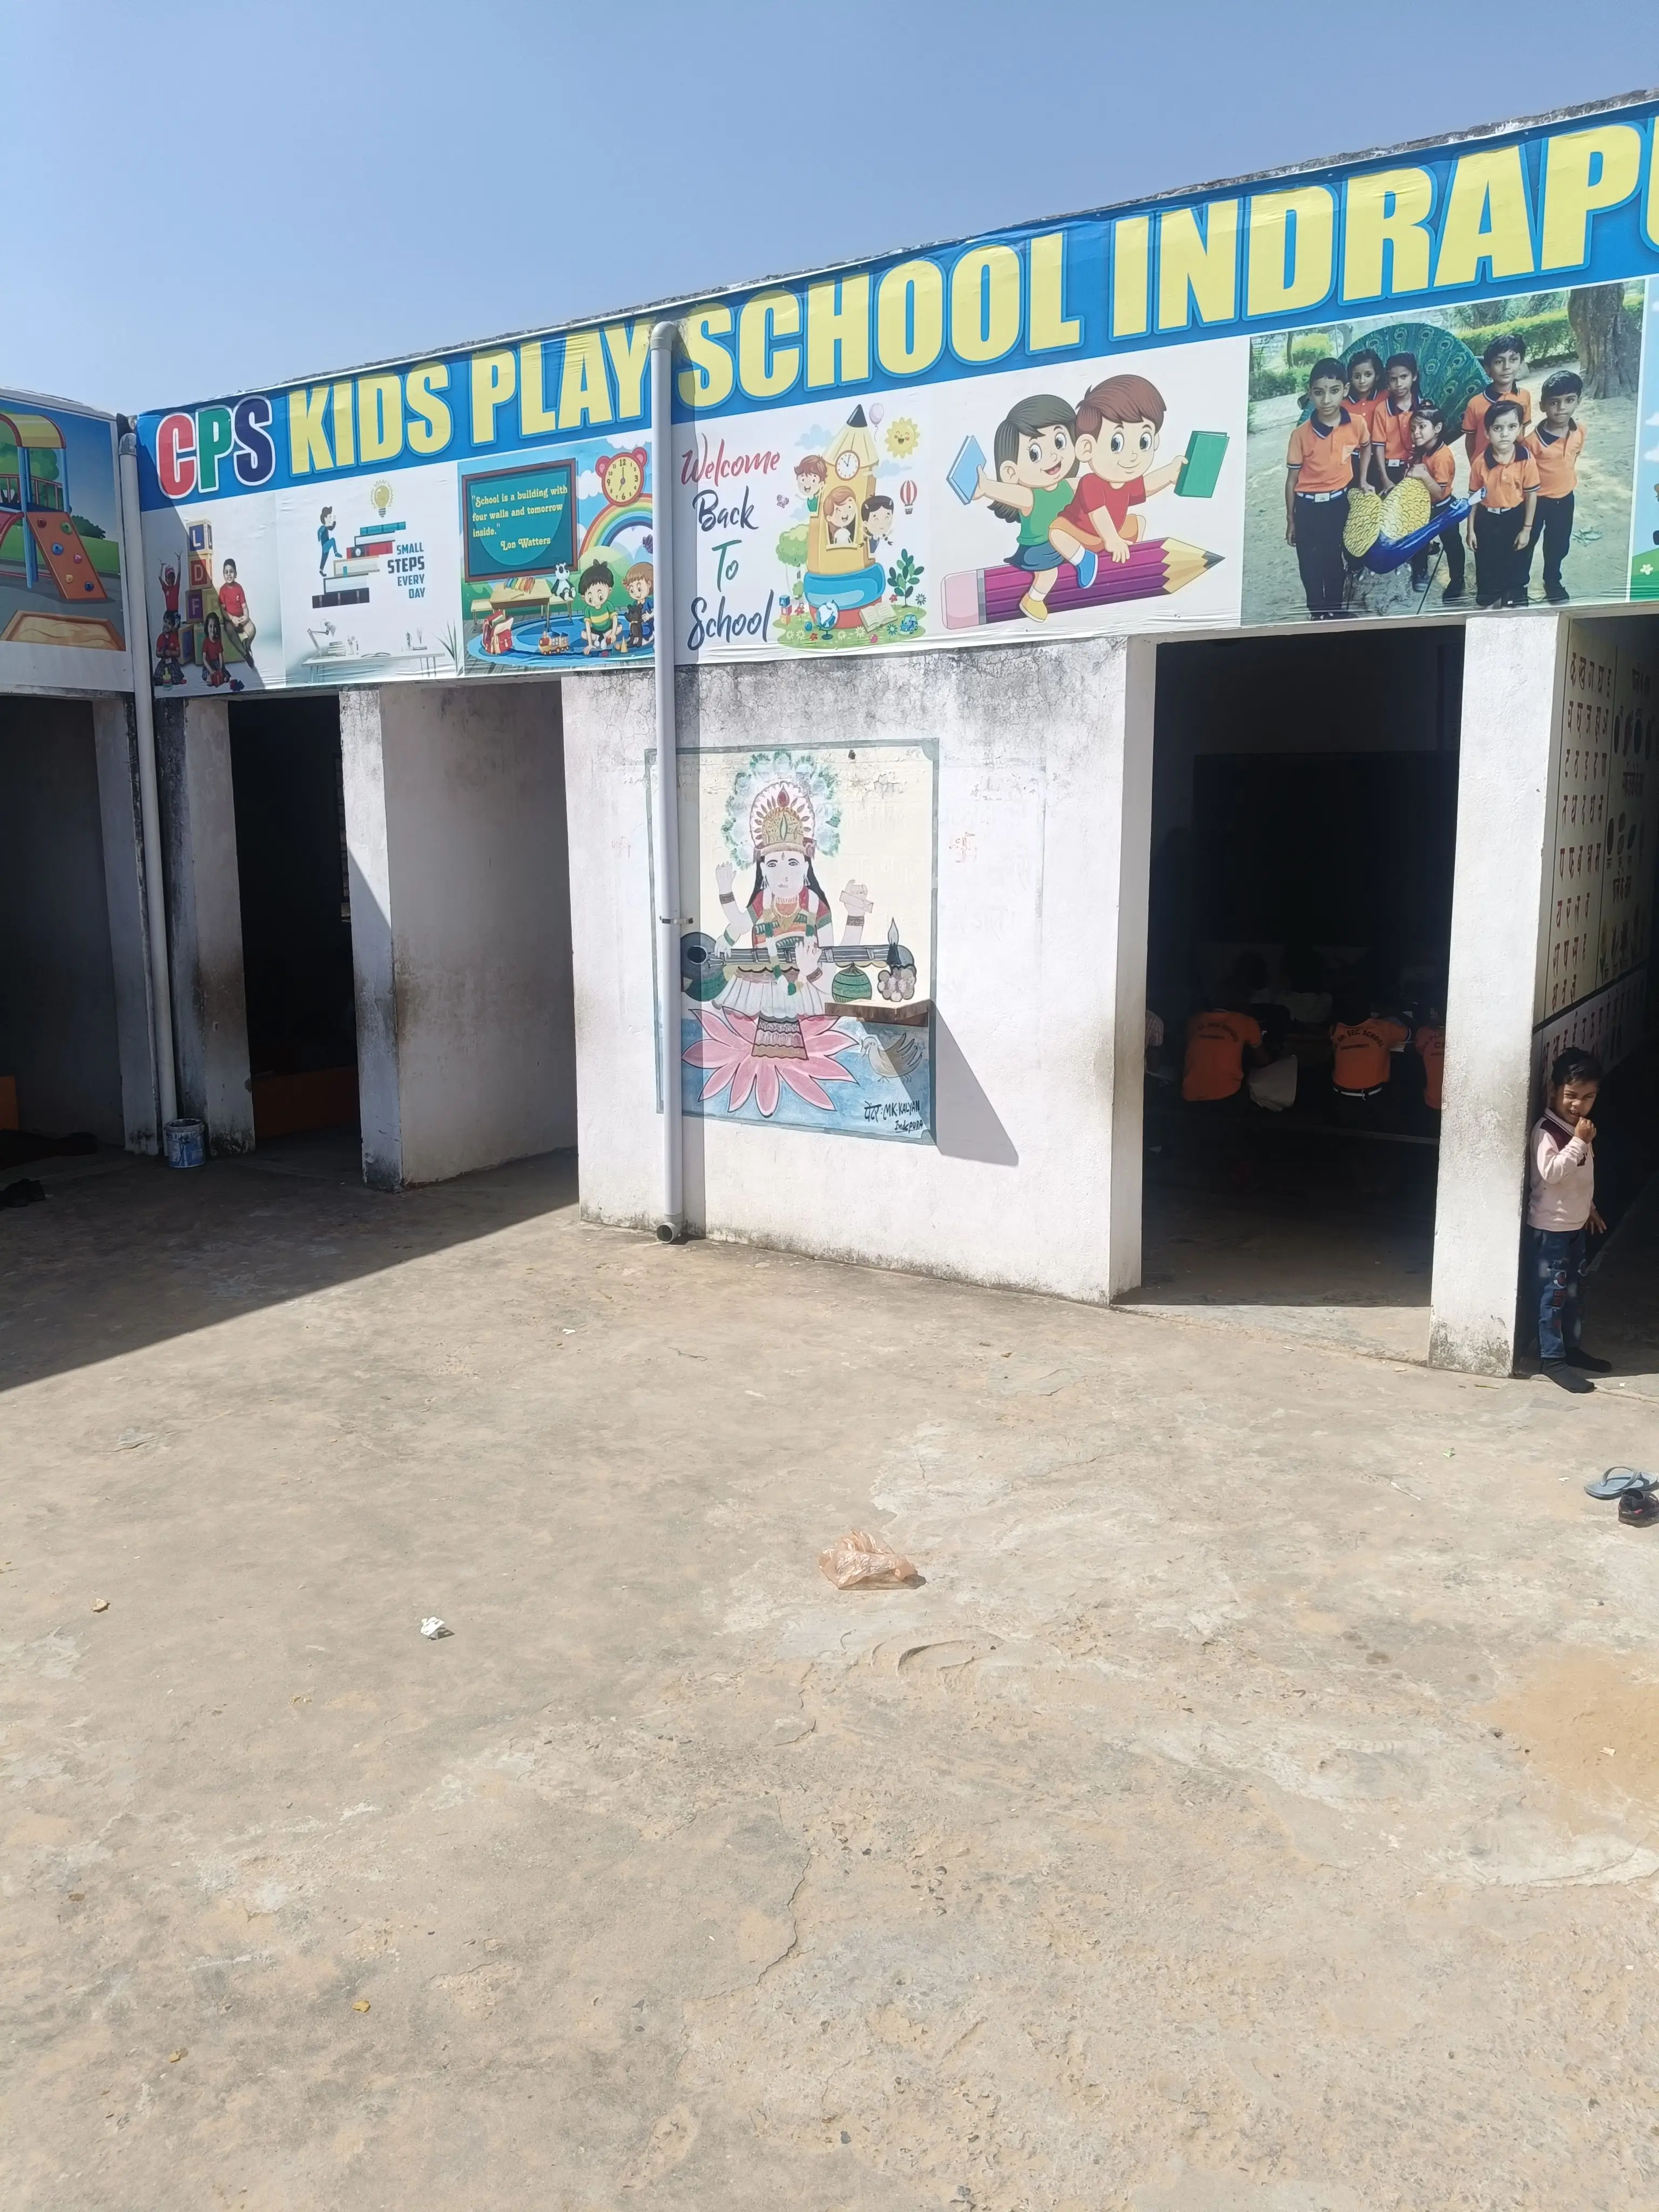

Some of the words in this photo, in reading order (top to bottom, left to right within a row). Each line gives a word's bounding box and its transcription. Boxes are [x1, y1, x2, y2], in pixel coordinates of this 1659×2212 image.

[157, 395, 275, 499] CPS
[288, 360, 451, 475] KIDS
[471, 316, 653, 446] PLAY
[677, 232, 1080, 409] SCHOOL
[1112, 115, 1659, 339] INDRAP
[619, 458, 626, 467] 12
[681, 433, 780, 487] Welcome
[471, 494, 500, 508] "School
[502, 493, 509, 502] is
[517, 487, 549, 500] building
[550, 484, 568, 496] with
[472, 512, 487, 522] four
[490, 509, 509, 520] walls
[511, 506, 525, 517] and
[527, 503, 563, 514] tomorrow
[692, 485, 759, 531] Back
[192, 529, 201, 548] L
[500, 540, 516, 551] Lon
[518, 537, 551, 549] Watters
[396, 542, 424, 555] SMALL
[194, 564, 204, 582] D
[387, 556, 424, 574] STEPS
[711, 539, 742, 592] To
[397, 574, 425, 586] EVERY
[409, 587, 426, 599] DAY
[192, 598, 200, 613] F
[687, 589, 774, 651] School
[1363, 1030, 1384, 1048] SCHOOL
